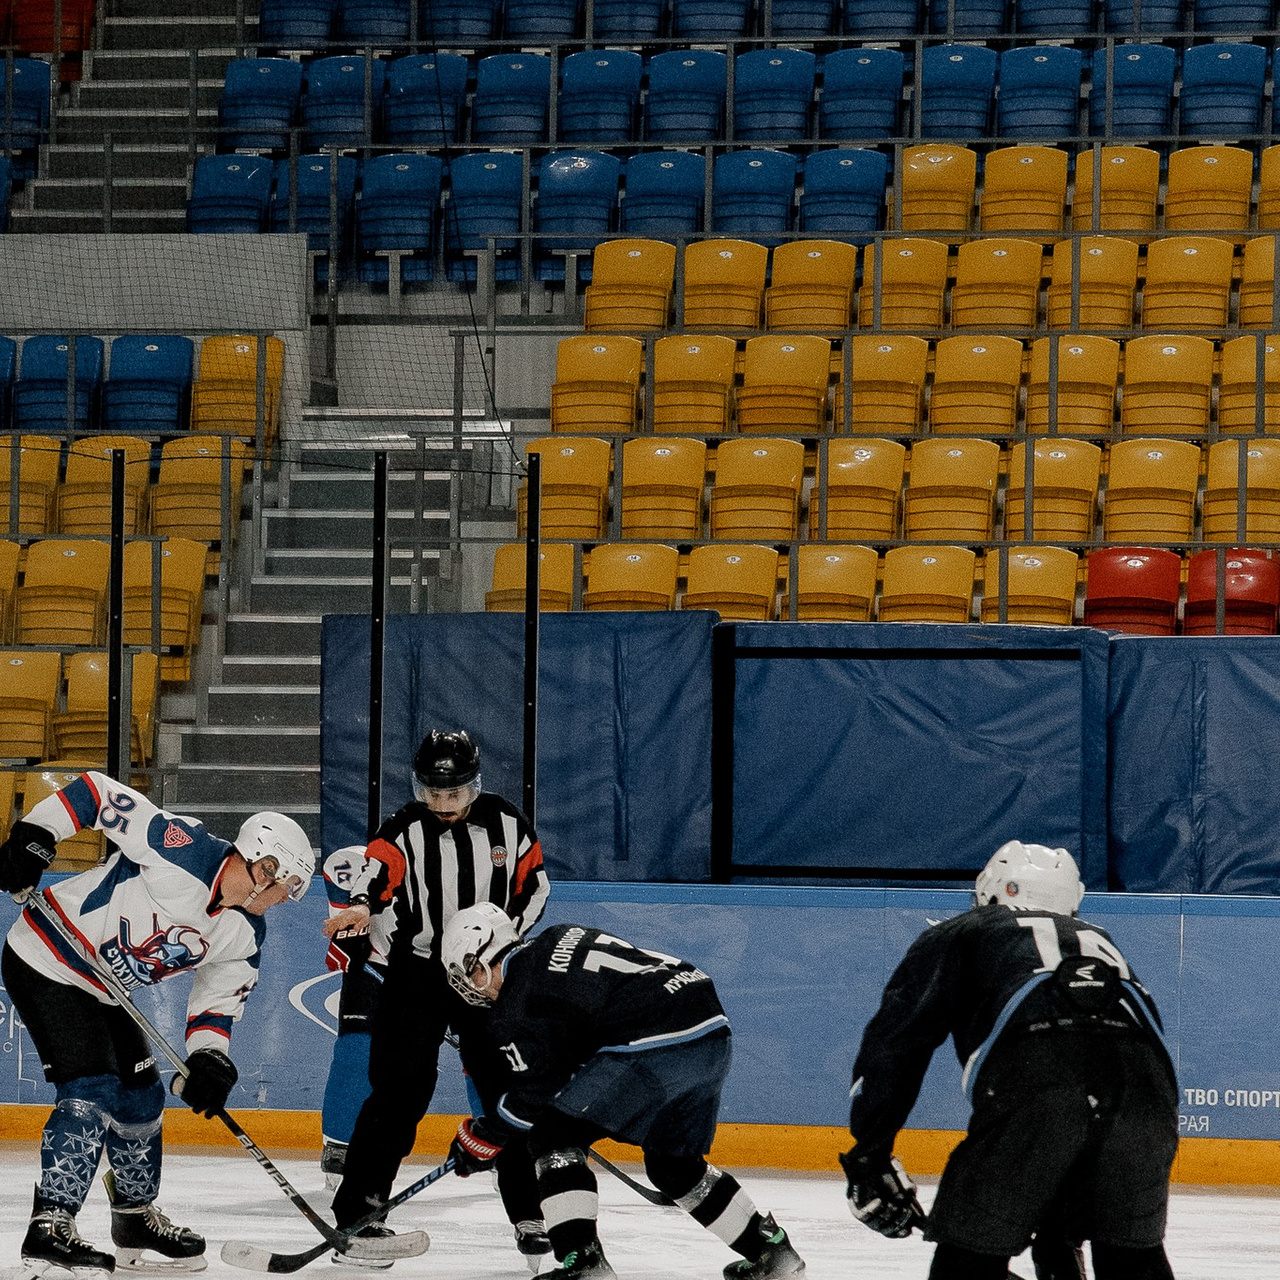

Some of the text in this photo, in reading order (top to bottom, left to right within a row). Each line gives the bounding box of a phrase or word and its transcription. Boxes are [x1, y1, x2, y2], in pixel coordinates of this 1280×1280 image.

[100, 787, 139, 836] 95
[548, 927, 586, 972] КОНОНО
[237, 1133, 299, 1198] BAUER
